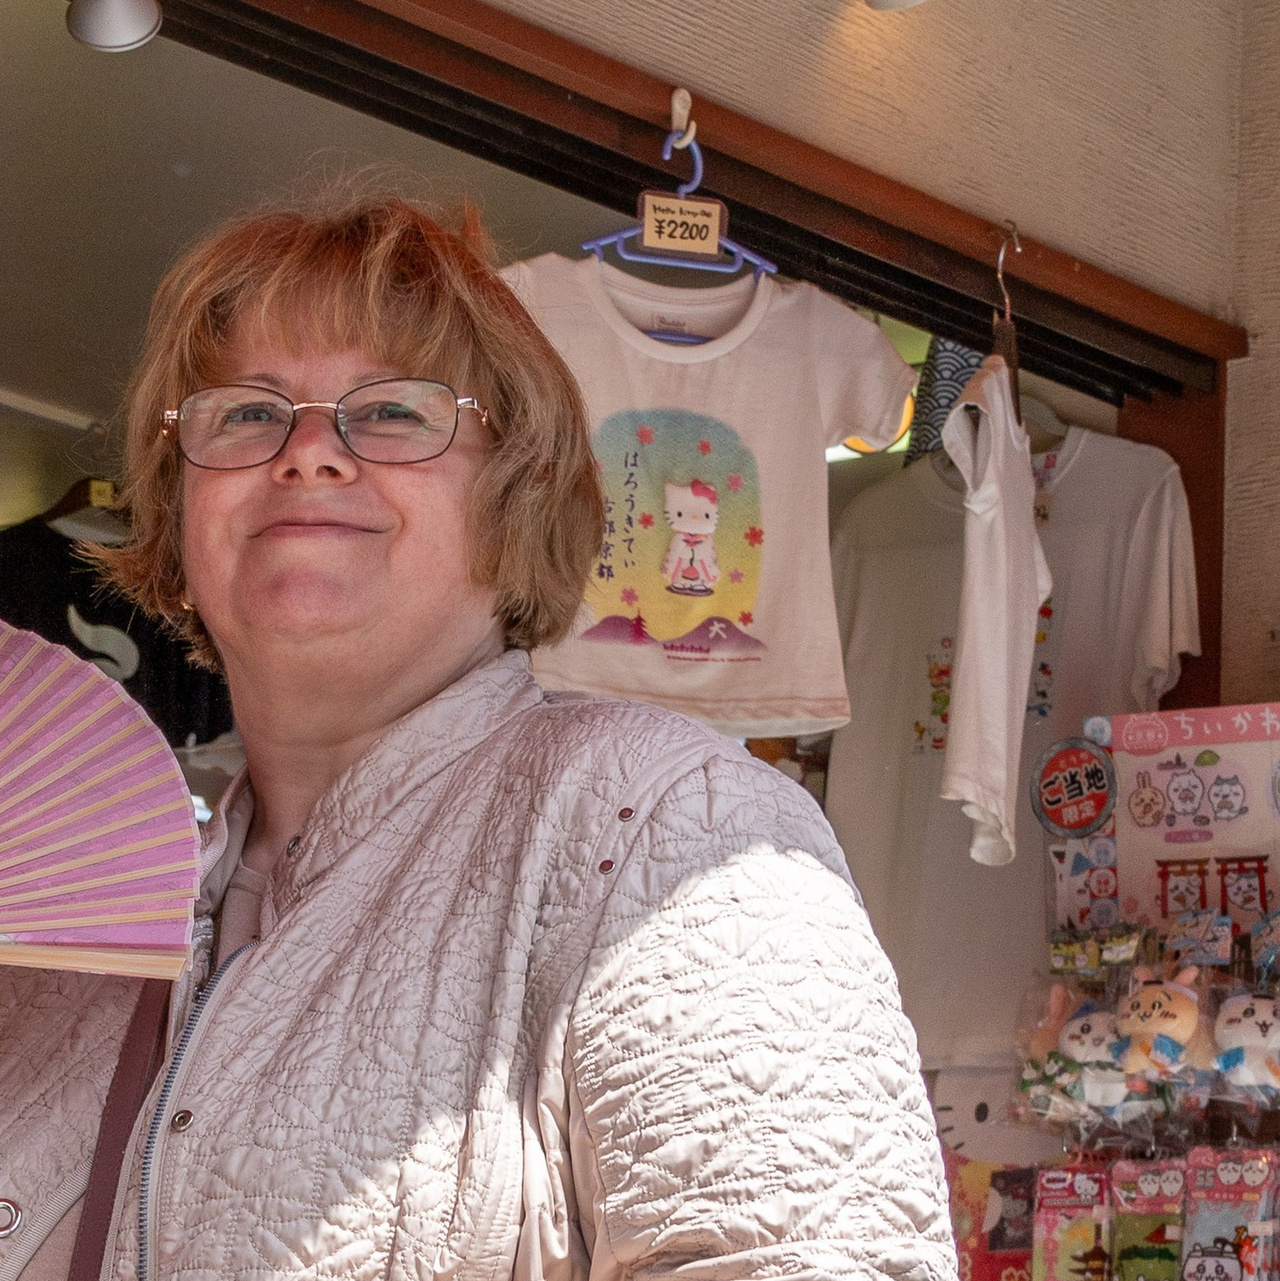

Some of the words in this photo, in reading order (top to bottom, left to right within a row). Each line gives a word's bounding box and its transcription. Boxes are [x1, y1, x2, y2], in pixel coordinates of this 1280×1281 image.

[653, 218, 710, 240] ¥2200
[708, 621, 728, 640] 大
[1043, 762, 1107, 807] ご当地
